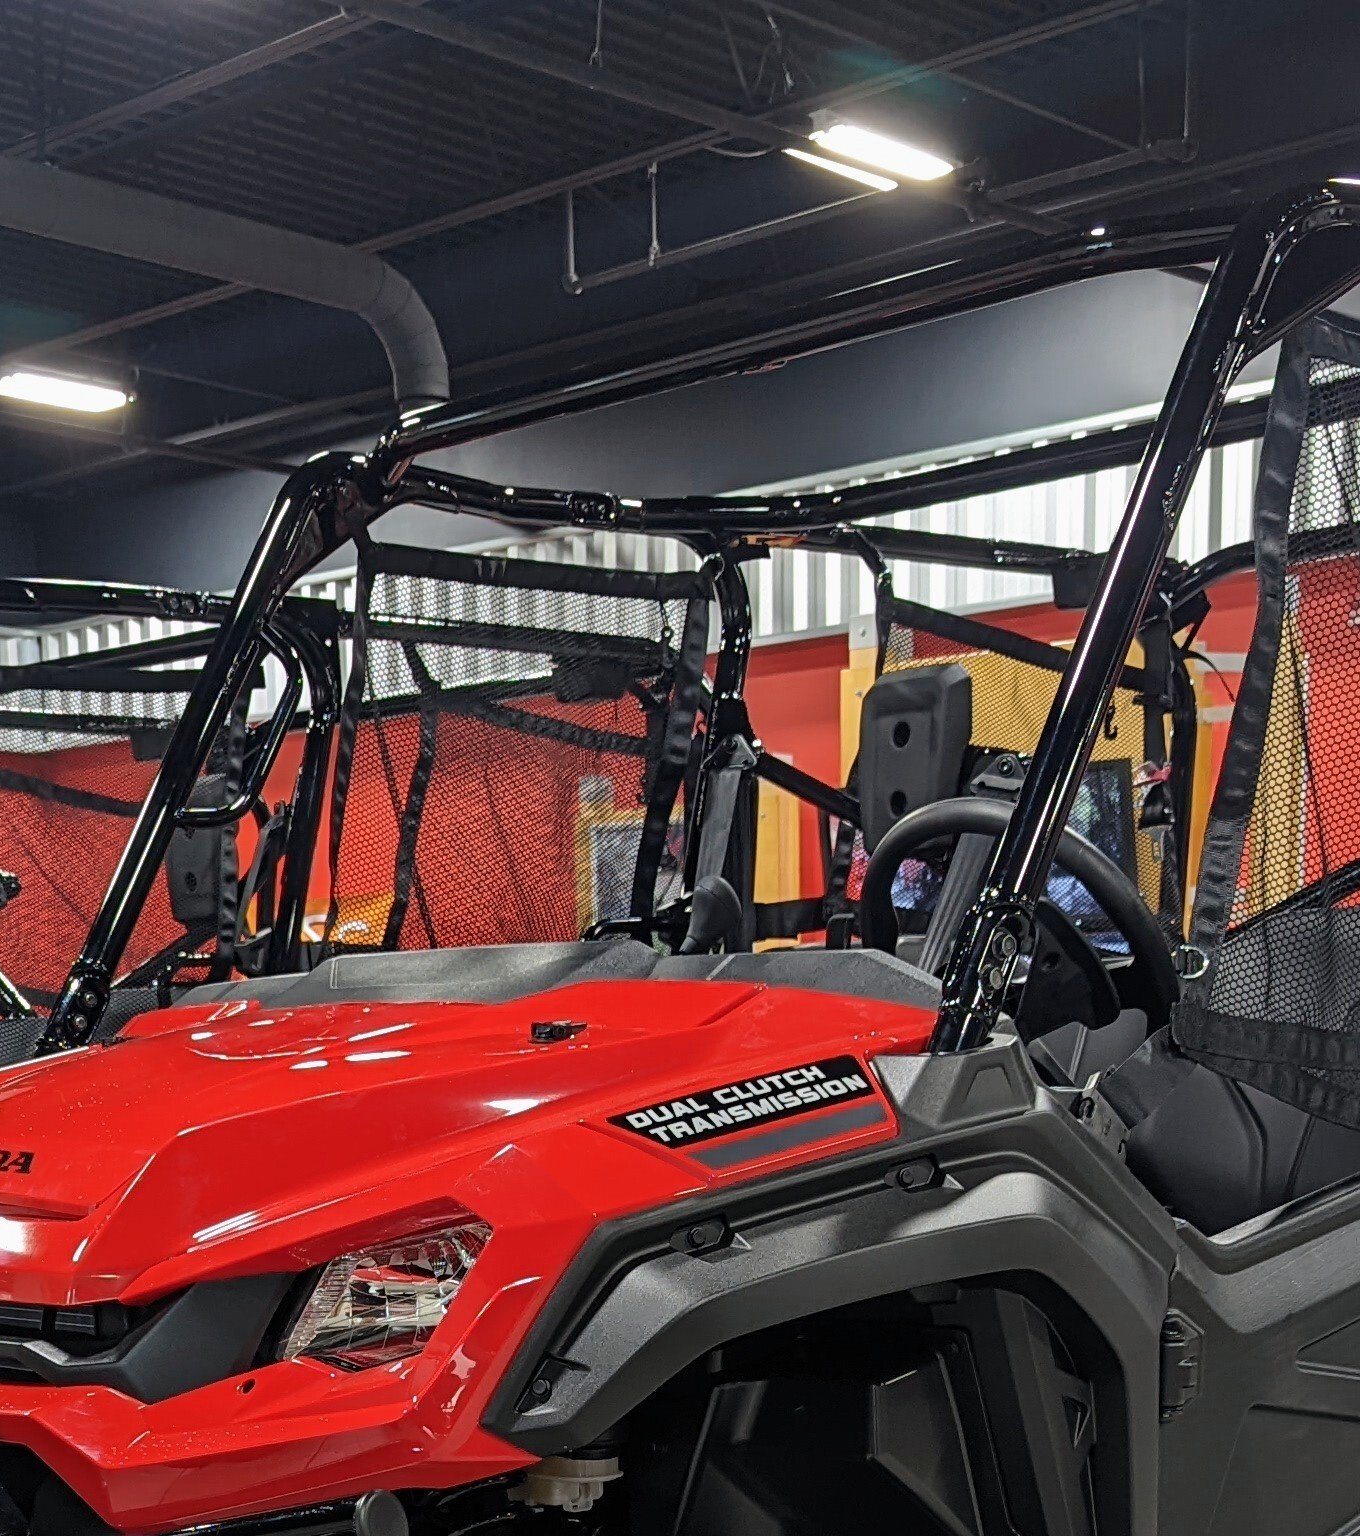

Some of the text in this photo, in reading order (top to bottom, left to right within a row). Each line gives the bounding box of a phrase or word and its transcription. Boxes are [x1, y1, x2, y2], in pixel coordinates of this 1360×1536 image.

[625, 1065, 826, 1129] DUAL CLUTCH
[649, 1073, 868, 1142] TRANSMISSION
